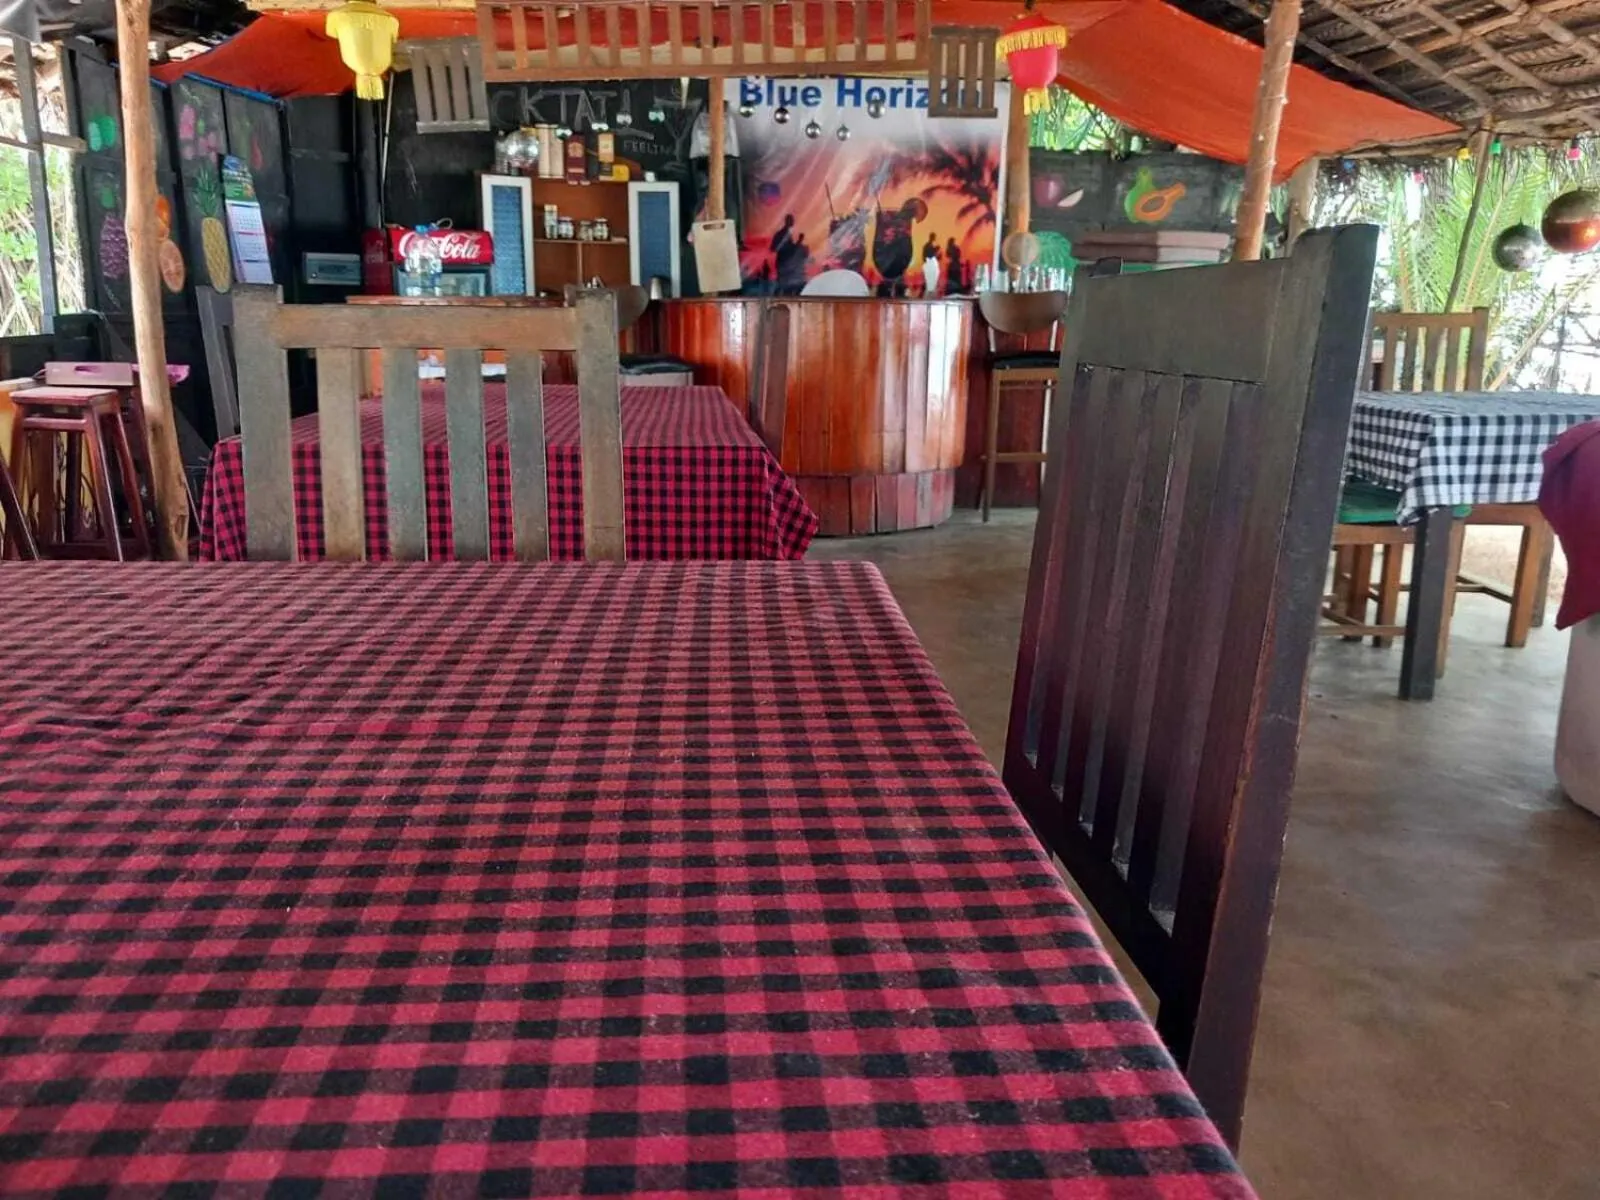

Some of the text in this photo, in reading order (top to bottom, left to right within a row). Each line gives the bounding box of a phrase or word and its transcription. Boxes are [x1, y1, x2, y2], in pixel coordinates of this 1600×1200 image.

[740, 74, 974, 108] Blue Horiz
[490, 86, 655, 141] CKTAIL
[398, 231, 483, 260] C-Cola
